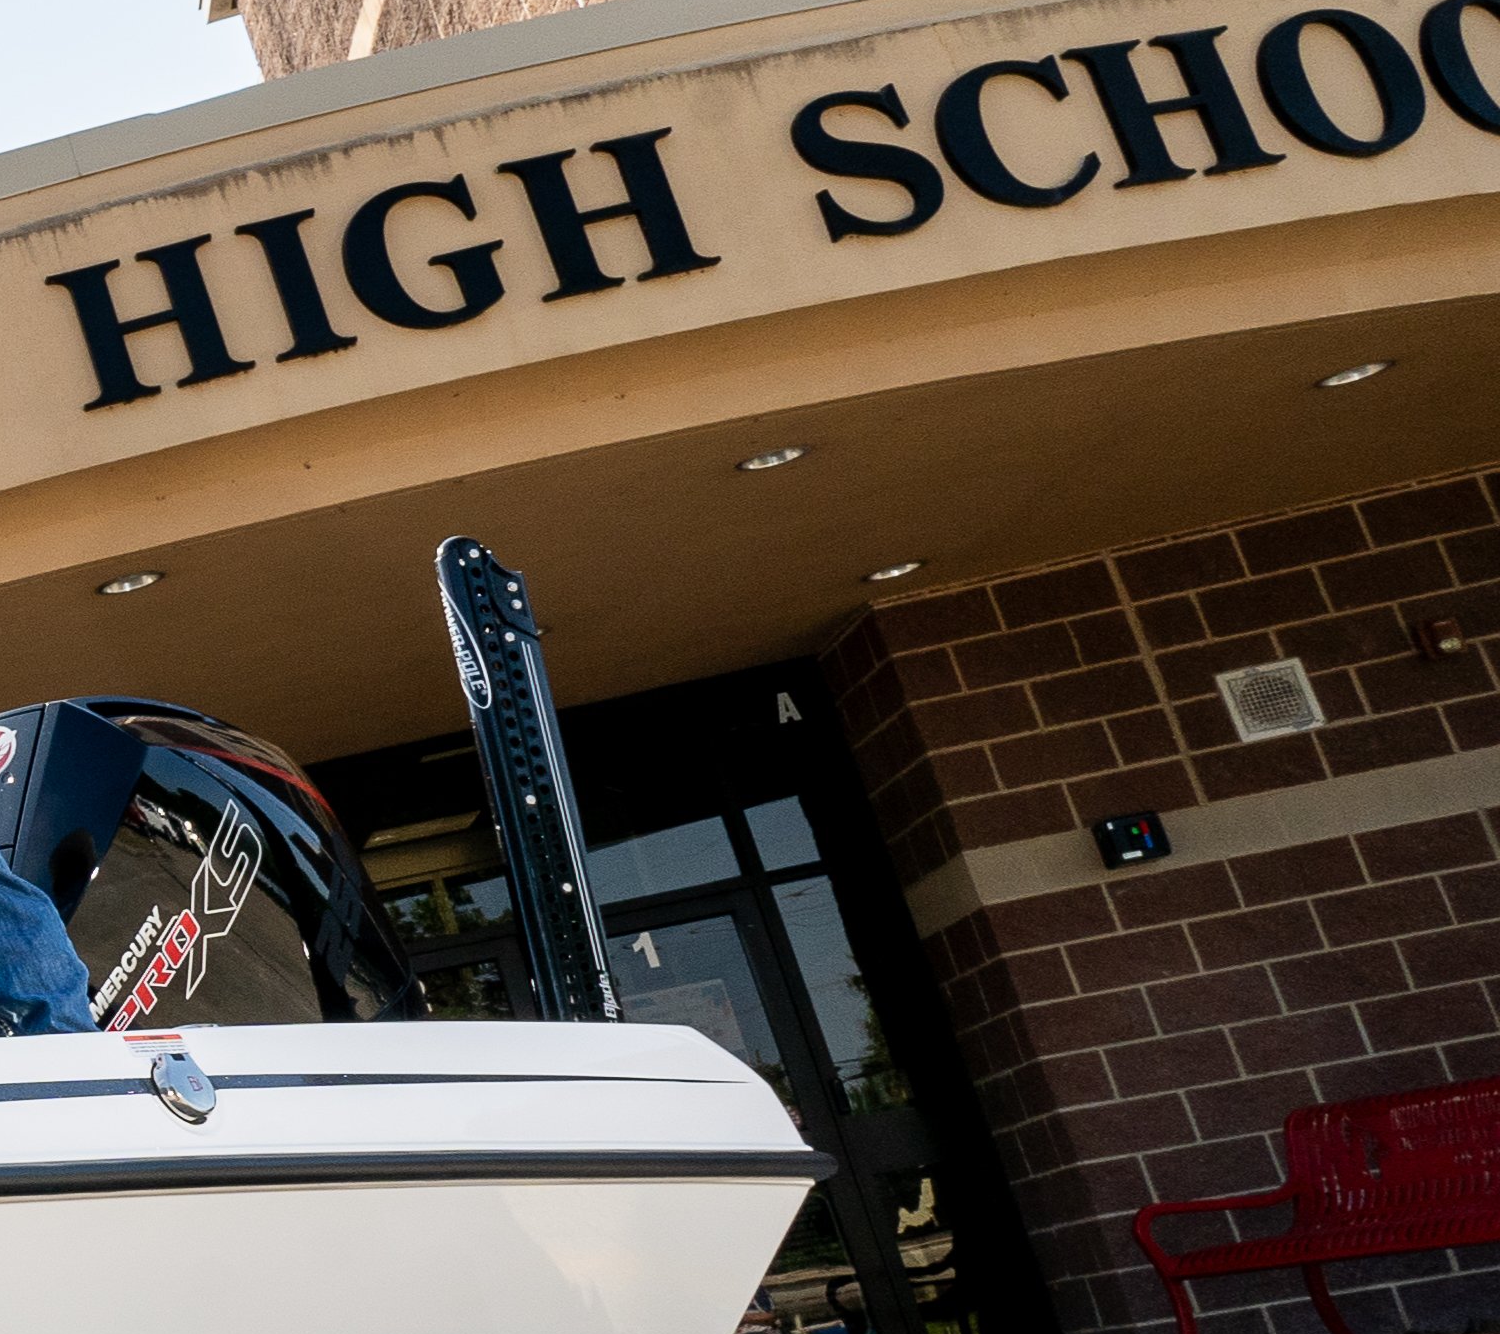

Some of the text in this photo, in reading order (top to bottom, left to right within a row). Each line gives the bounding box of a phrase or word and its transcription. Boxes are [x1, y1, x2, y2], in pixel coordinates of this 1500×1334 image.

[46, 127, 722, 413] HIGH
[777, 692, 803, 724] A
[88, 905, 163, 1023] MERCURY
[104, 798, 262, 1032] PRO XS
[631, 931, 661, 968] 1
